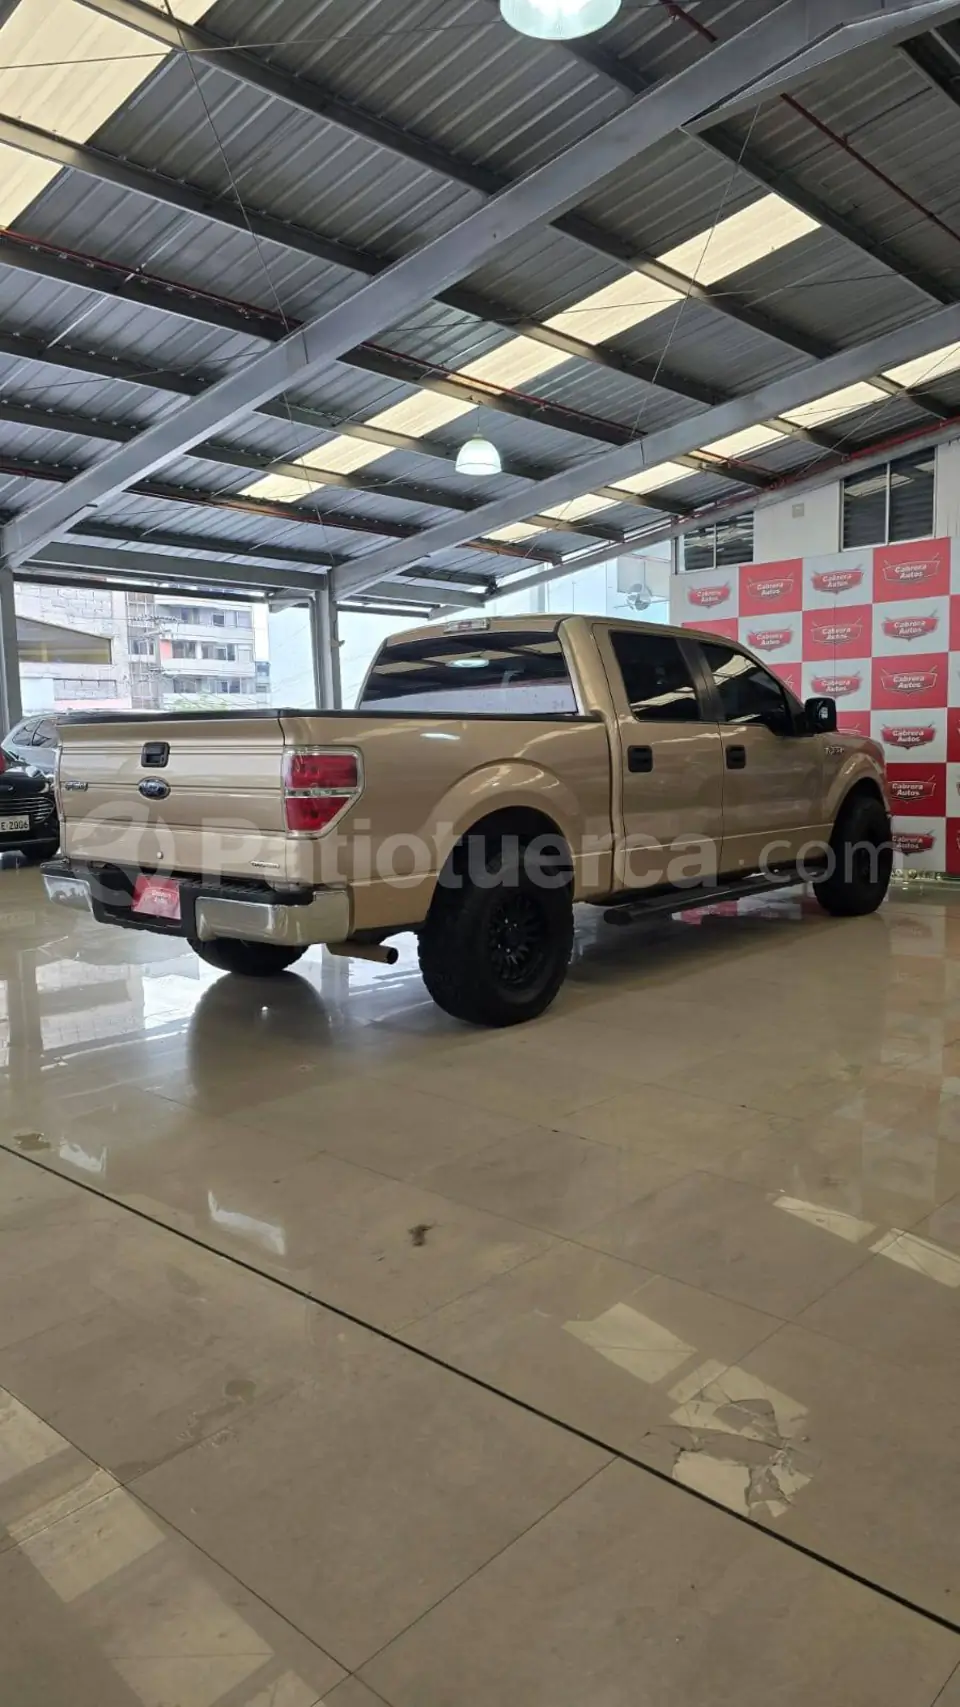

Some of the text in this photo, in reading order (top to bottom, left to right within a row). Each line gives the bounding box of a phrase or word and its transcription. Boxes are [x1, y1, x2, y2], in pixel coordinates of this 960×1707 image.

[893, 729, 925, 738] Cabrera
[897, 735, 921, 743] Autos
[892, 783, 924, 791] Cabrera
[896, 788, 920, 796] Autos
